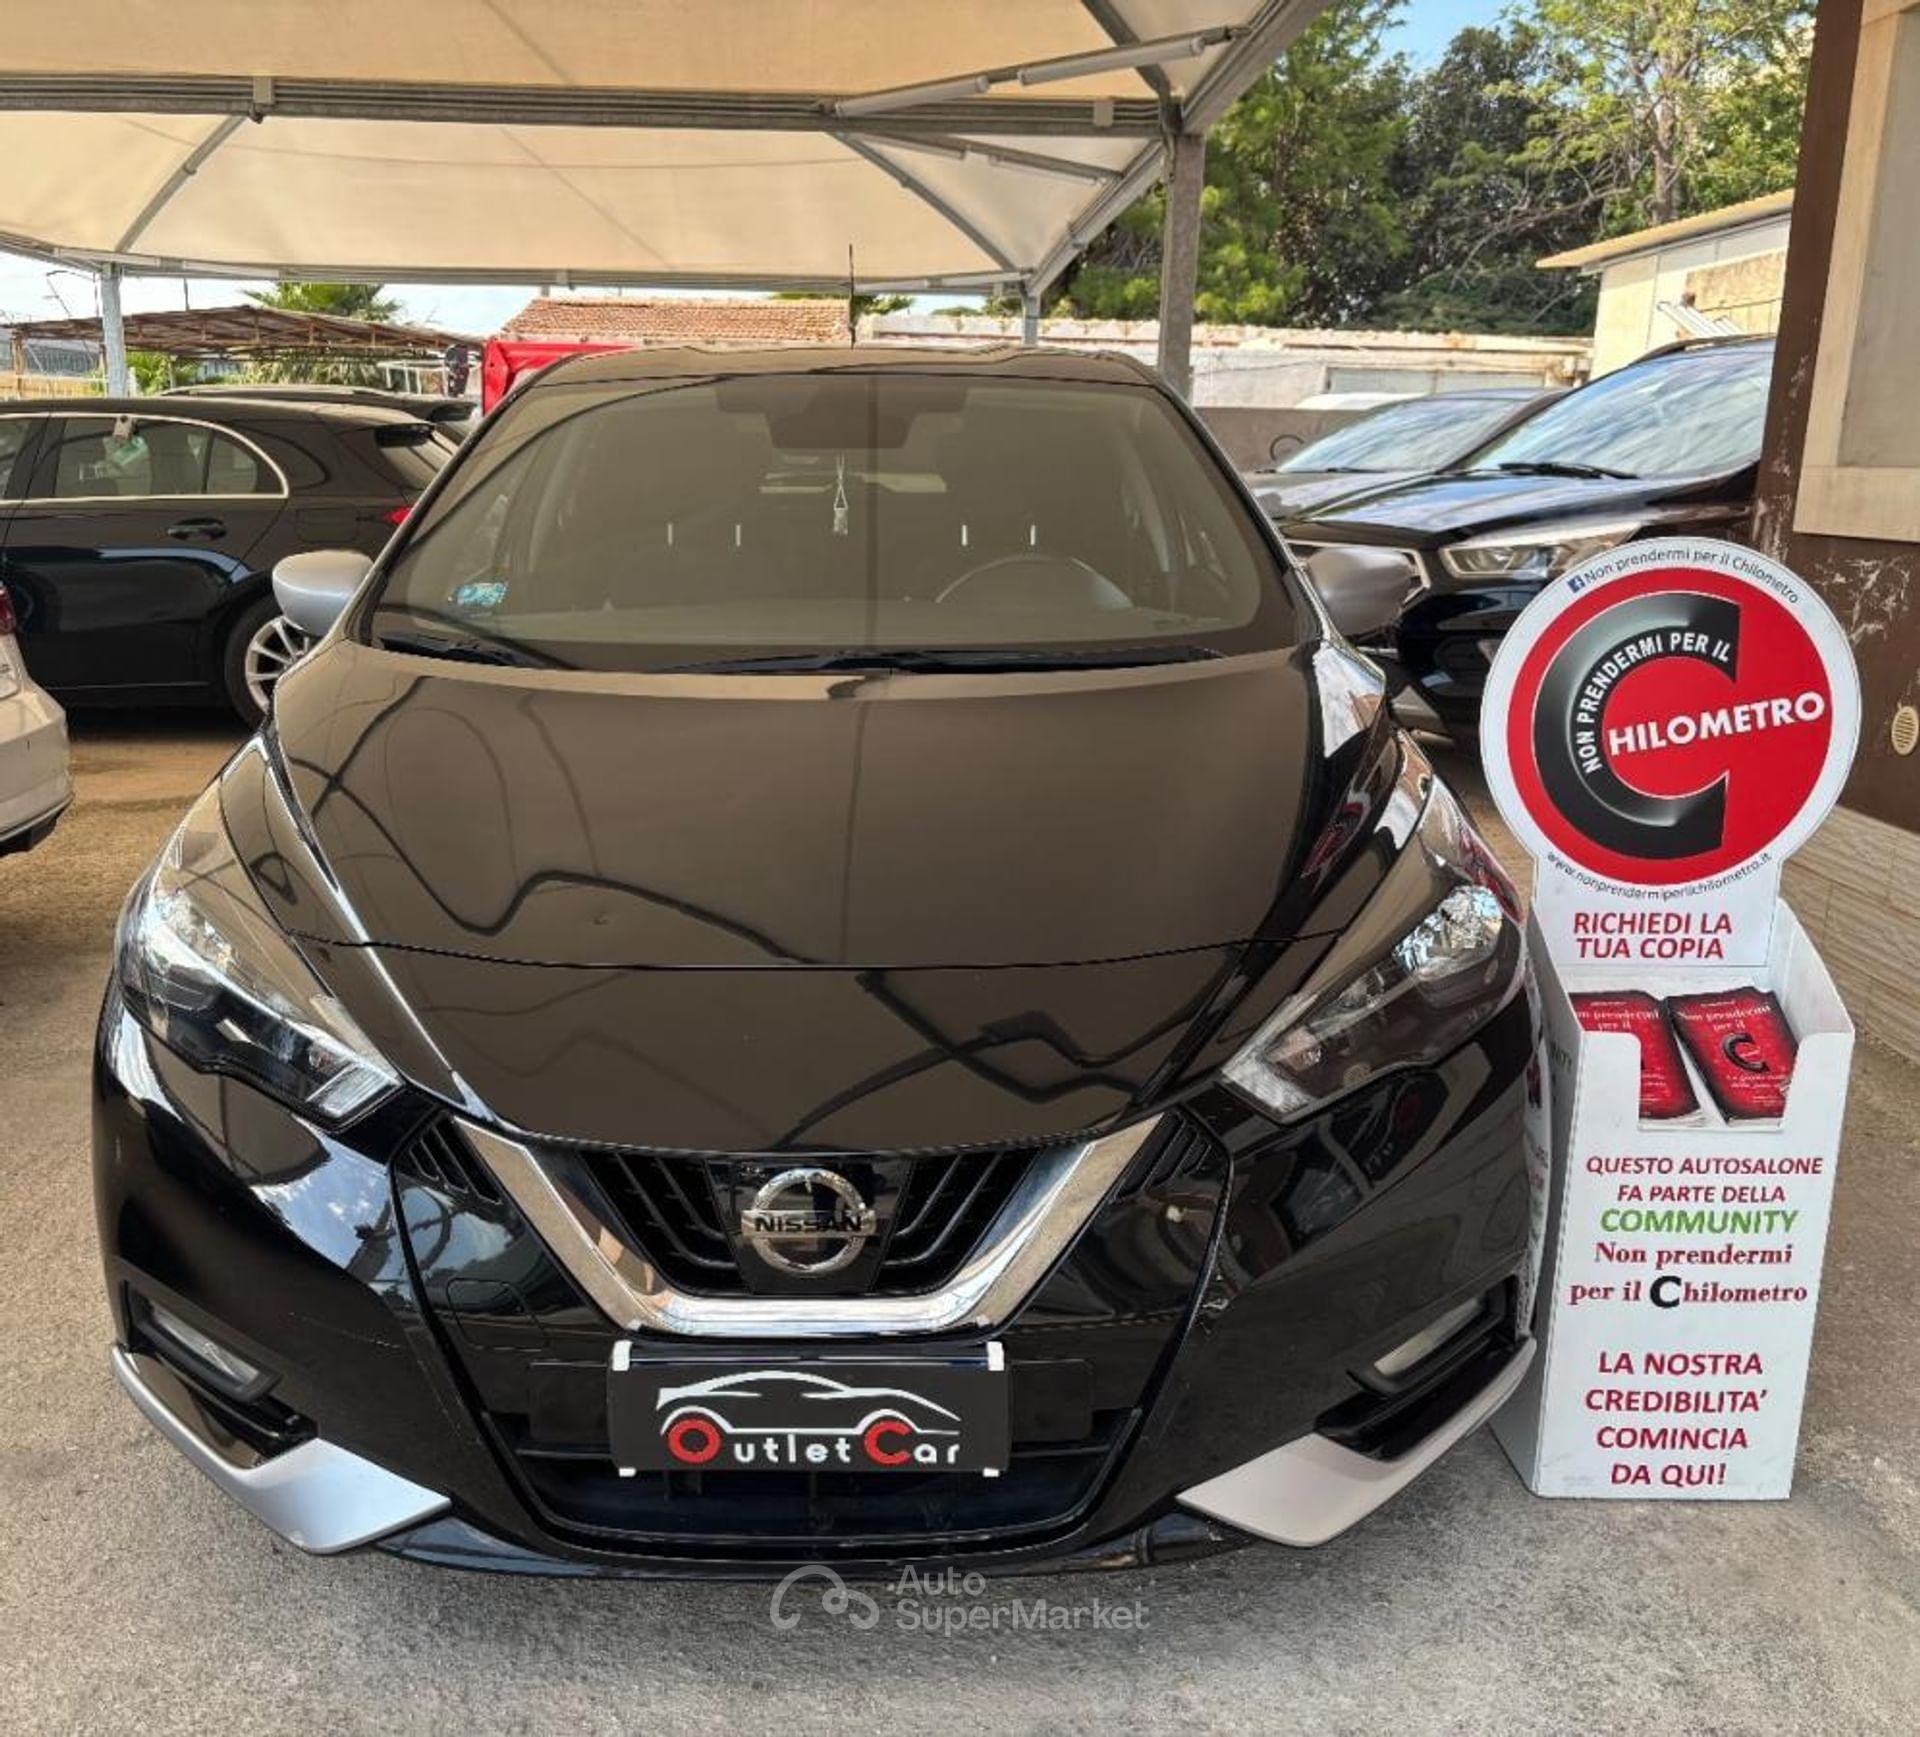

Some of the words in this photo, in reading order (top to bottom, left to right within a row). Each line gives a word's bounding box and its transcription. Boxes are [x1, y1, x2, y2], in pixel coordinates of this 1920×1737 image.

[1583, 564, 1613, 584] Non
[1615, 547, 1691, 573] prendermi
[1693, 550, 1718, 562] per
[1719, 553, 1729, 566] il
[1732, 557, 1799, 604] Chilometro
[1669, 632, 1708, 652] PER
[1712, 640, 1732, 662] IL
[1577, 634, 1664, 722] PRENDERMI
[1582, 726, 1602, 774] NON
[1573, 912, 1691, 935] RICHIEDI
[1700, 912, 1732, 935] LA
[1576, 938, 1631, 959] TUA
[1639, 938, 1724, 959] COPIA
[1586, 1158, 1673, 1175] QUESTO
[1679, 1158, 1823, 1175] AUTOSALONE
[1617, 1185, 1643, 1201] FA
[1649, 1186, 1715, 1202] PARTE
[1722, 1186, 1786, 1202] DELLA
[754, 1215, 862, 1233] NISSAN
[1601, 1209, 1799, 1234] COMMUNITY
[1595, 1243, 1647, 1264] Non
[1655, 1244, 1793, 1270] prendermi
[1569, 1285, 1614, 1306] per
[1623, 1280, 1641, 1301] il
[1649, 1275, 1808, 1309] Chilometro
[1598, 1352, 1634, 1375] LA
[1643, 1353, 1763, 1375] NOSTRA
[1597, 1427, 1749, 1450] COMINCIA
[1610, 1465, 1651, 1485] DA
[1661, 1464, 1727, 1486] QUI!
